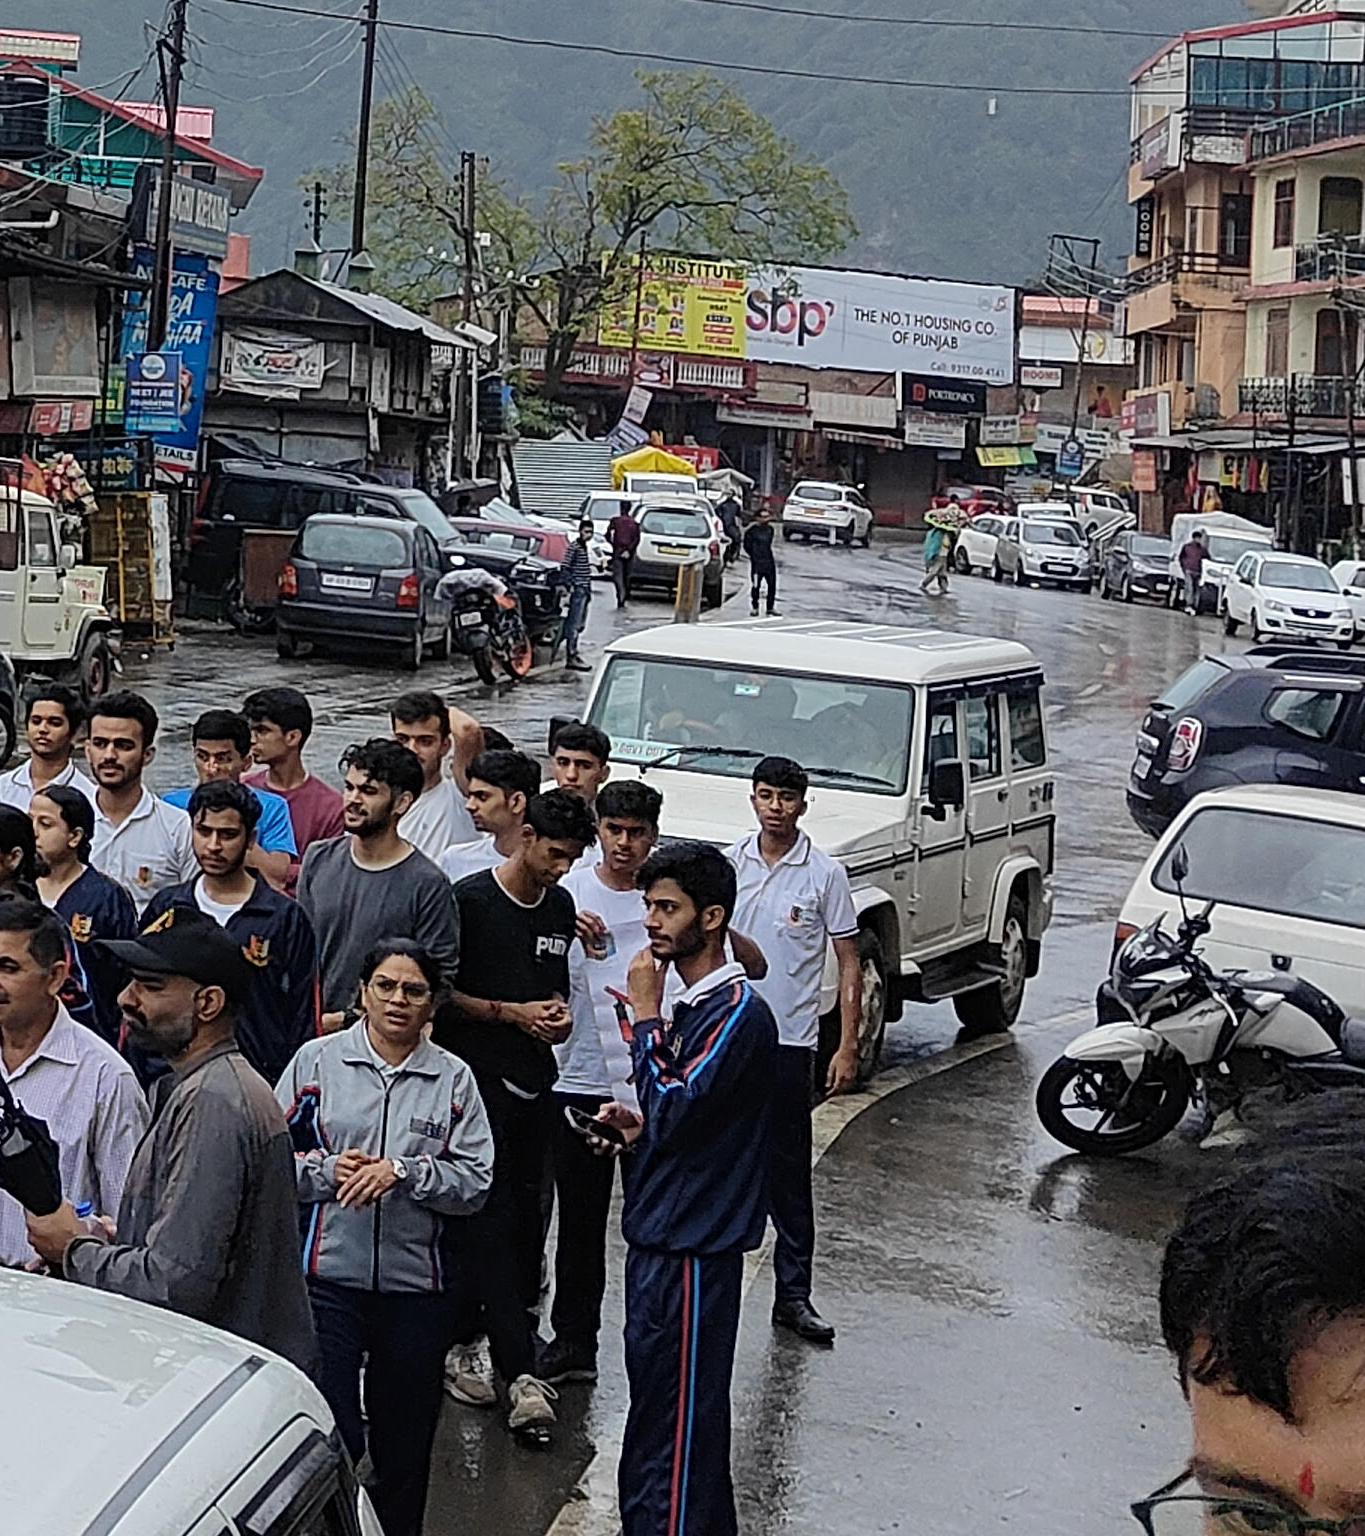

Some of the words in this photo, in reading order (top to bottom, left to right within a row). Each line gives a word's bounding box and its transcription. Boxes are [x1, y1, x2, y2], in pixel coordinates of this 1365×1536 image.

[854, 308, 877, 324] THE
[880, 311, 912, 327] NO.1
[914, 315, 972, 333] HOUSING
[974, 321, 998, 337] CO.
[892, 329, 910, 344] OF
[913, 333, 959, 352] PUNJAB
[1023, 368, 1060, 381] ROOMS
[155, 447, 194, 462] ETAILS
